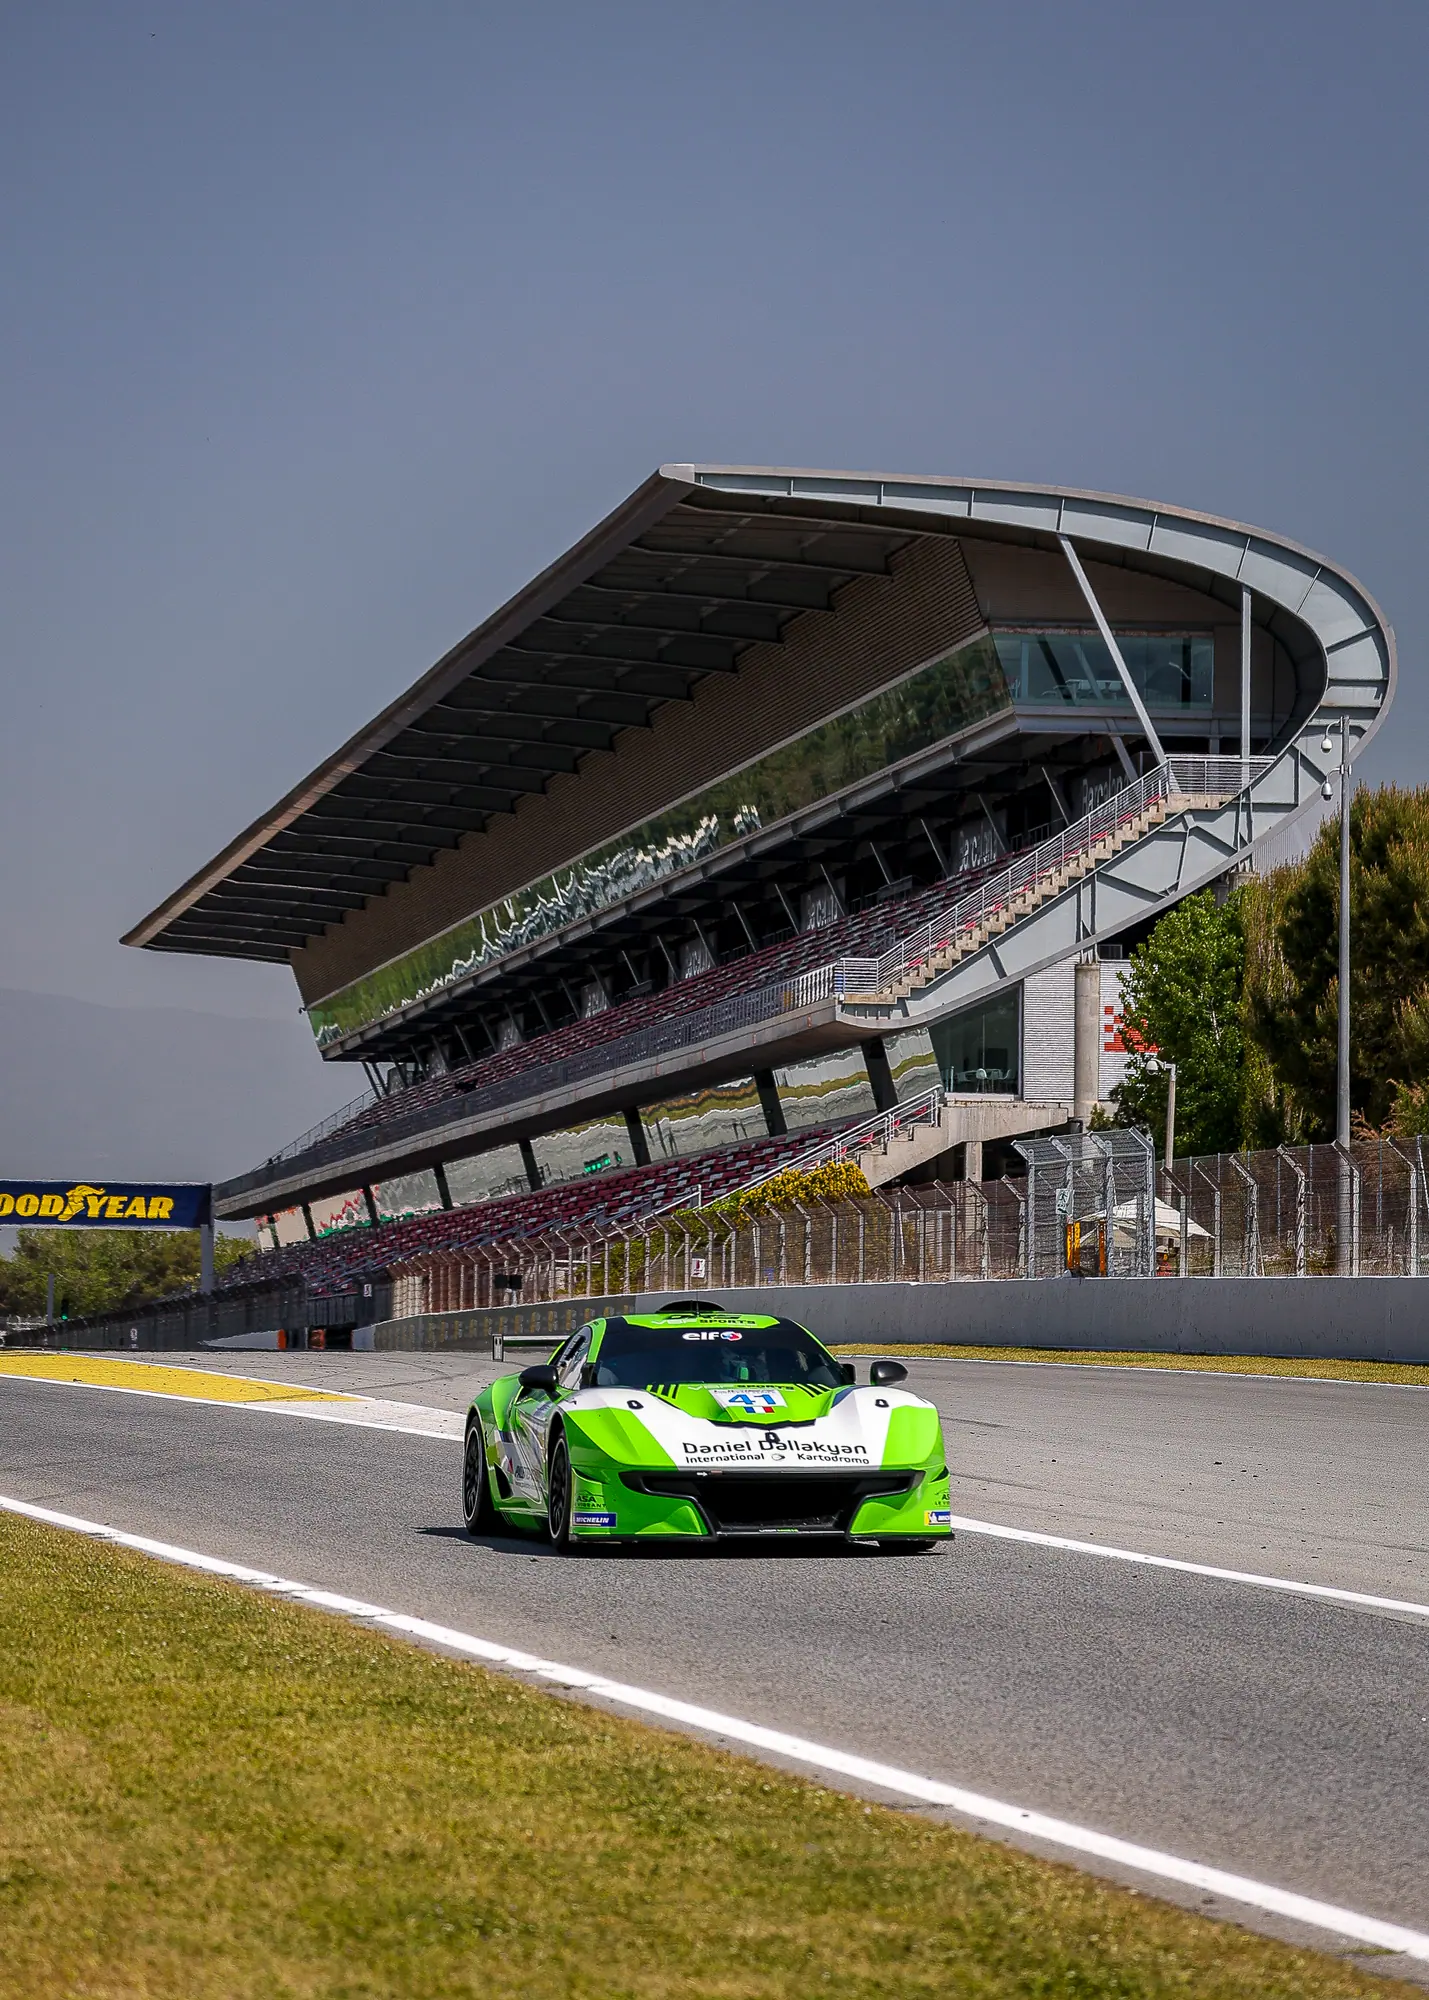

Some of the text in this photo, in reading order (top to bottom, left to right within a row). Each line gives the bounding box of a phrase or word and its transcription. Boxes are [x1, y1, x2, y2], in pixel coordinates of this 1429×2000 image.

[682, 1331, 720, 1341] elf
[728, 1394, 776, 1405] 41
[682, 1440, 867, 1456] Daniel Dallakyan
[685, 1453, 870, 1465] International Kartodromo
